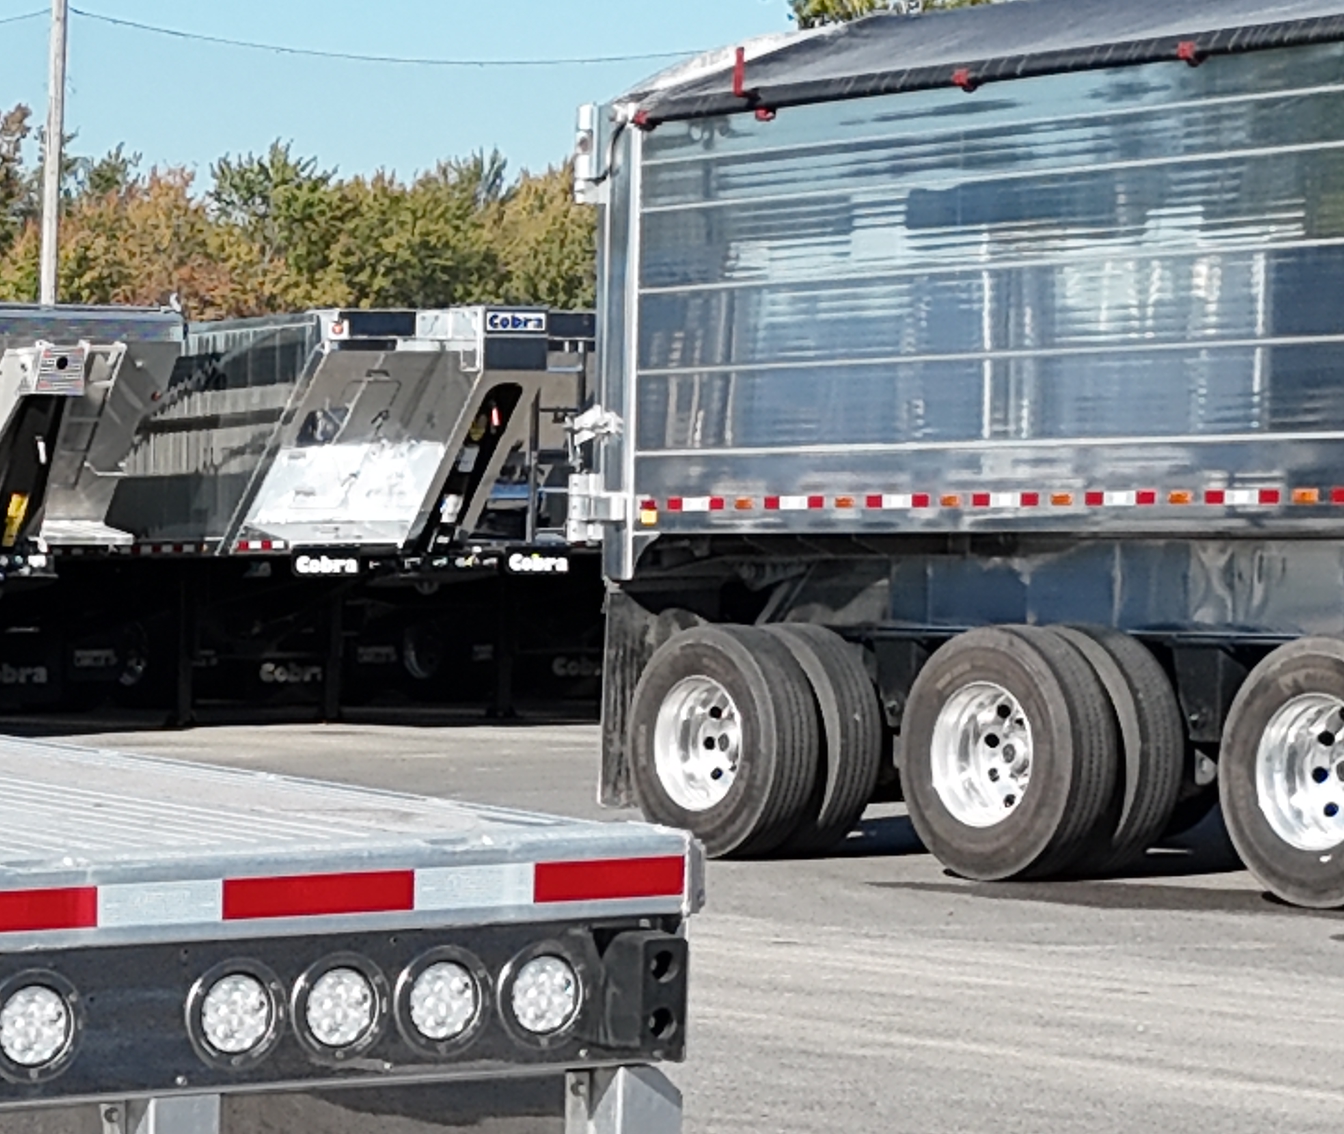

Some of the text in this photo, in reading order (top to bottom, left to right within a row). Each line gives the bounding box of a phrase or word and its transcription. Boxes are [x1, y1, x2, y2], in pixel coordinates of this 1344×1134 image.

[488, 314, 544, 329] Cobra
[295, 556, 358, 573] Cobra
[508, 553, 569, 572] Cobra
